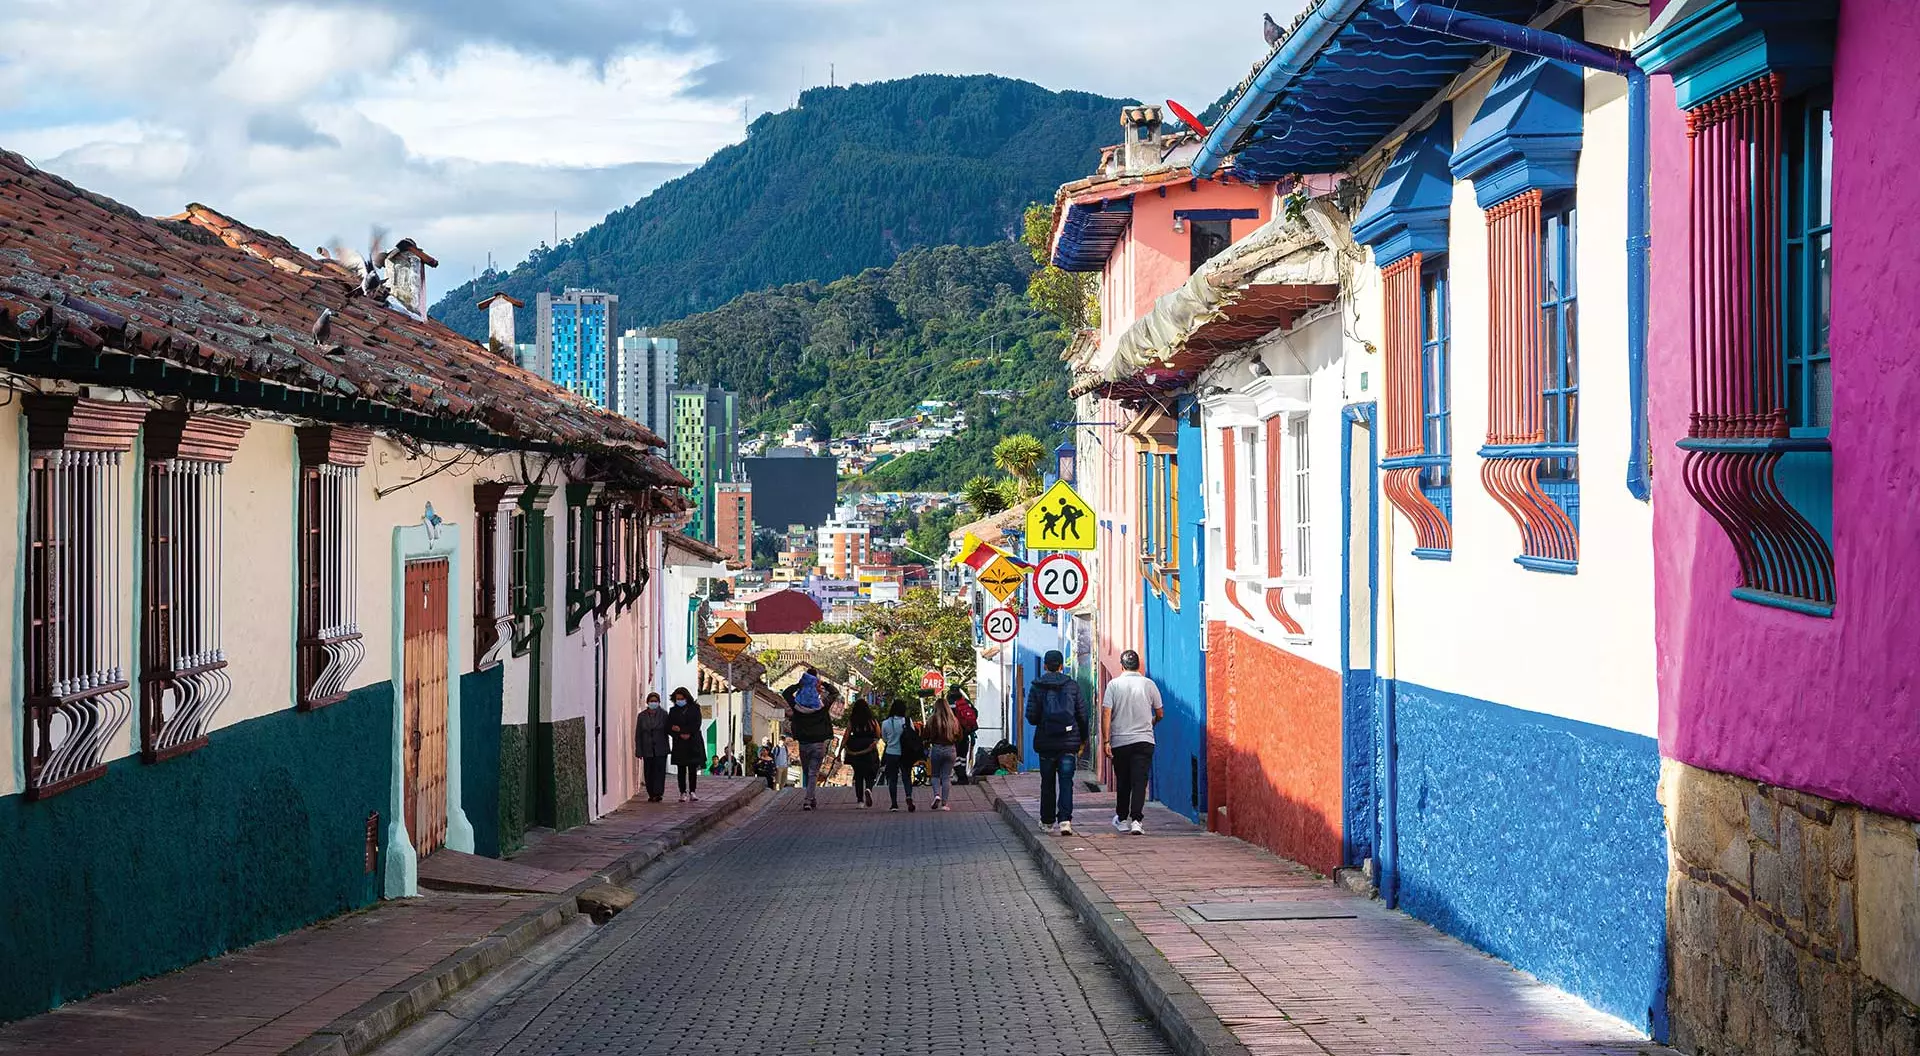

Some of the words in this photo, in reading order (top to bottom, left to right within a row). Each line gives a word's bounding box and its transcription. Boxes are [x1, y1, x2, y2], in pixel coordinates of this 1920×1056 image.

[1044, 569, 1078, 595] 20
[990, 617, 1012, 633] 20
[923, 678, 943, 689] PARE
